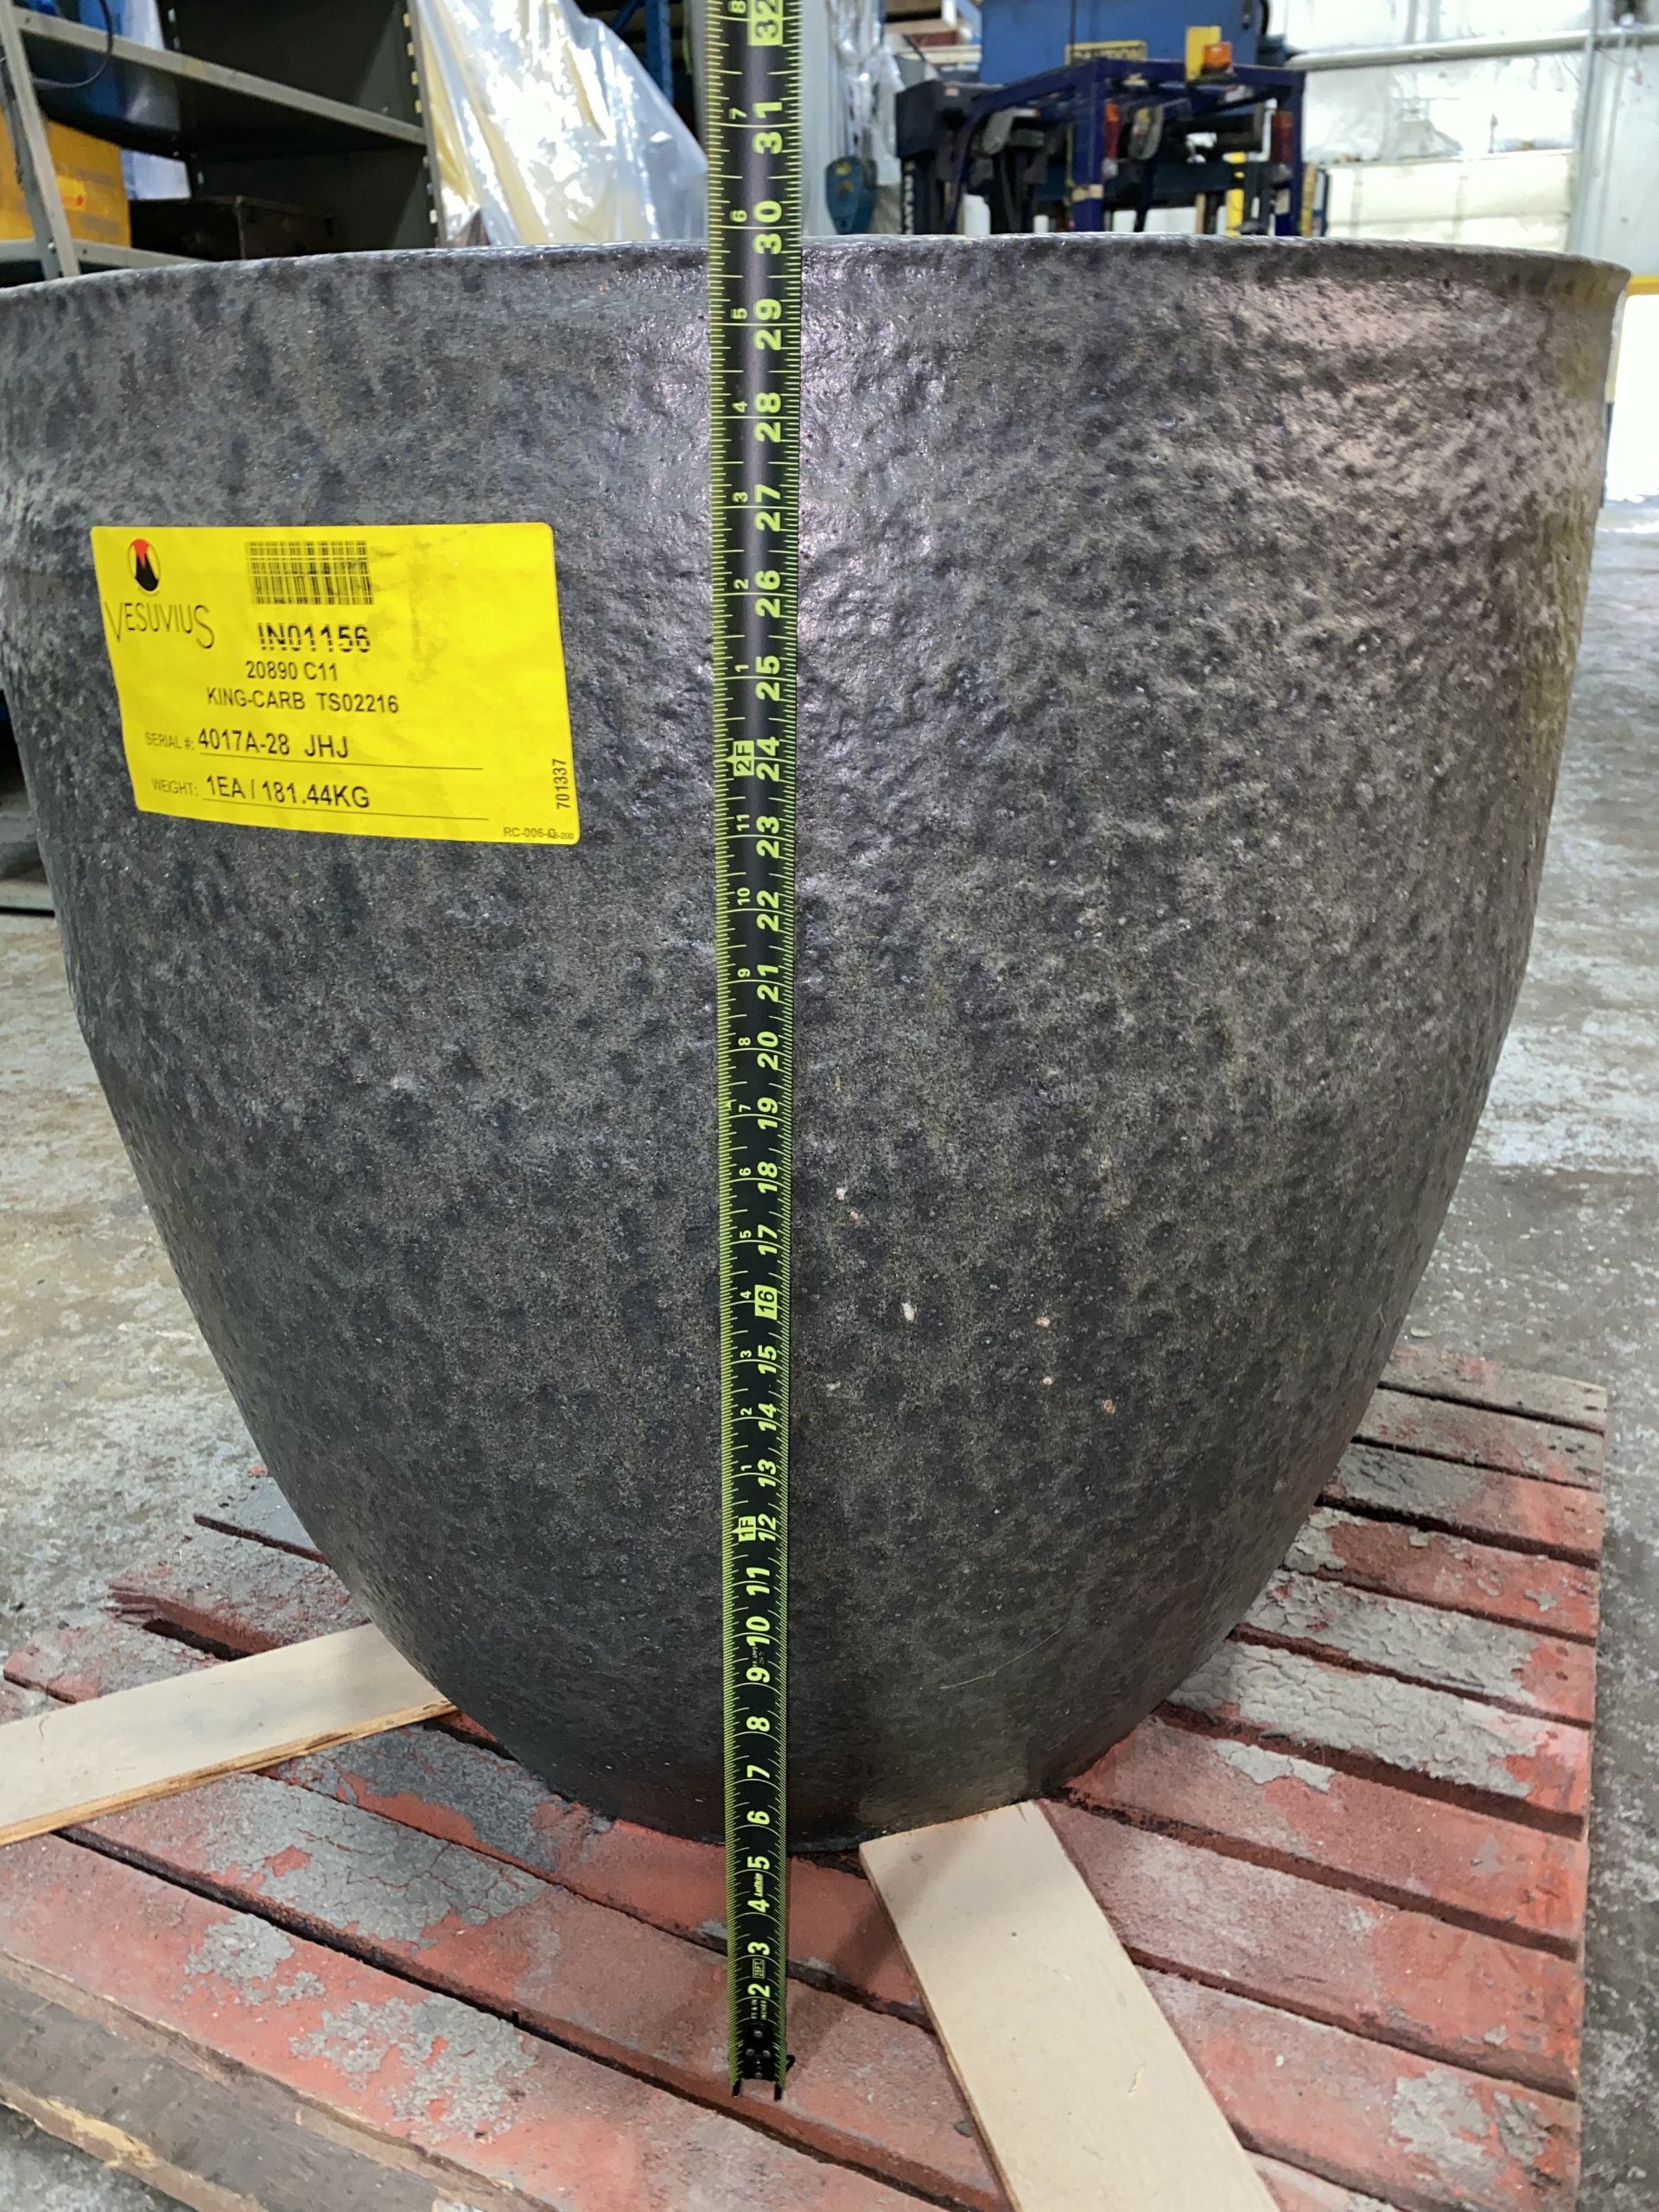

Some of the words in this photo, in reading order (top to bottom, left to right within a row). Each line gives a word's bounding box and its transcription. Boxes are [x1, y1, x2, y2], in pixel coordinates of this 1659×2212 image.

[728, 0, 747, 14] 8
[754, 0, 779, 38] 32
[728, 108, 747, 120] 7
[753, 102, 783, 154] 31
[729, 209, 747, 222] 6
[753, 200, 782, 254] 30
[730, 308, 747, 320] 5
[753, 298, 782, 350] 29
[732, 401, 747, 413] 4
[754, 392, 781, 442] 28
[732, 492, 748, 503] 3
[753, 484, 780, 531] 27
[734, 579, 748, 589] 2
[754, 569, 780, 618] 26
[104, 601, 215, 649] VESUVIUS
[258, 622, 371, 652] IN01156
[245, 660, 298, 680] 20890
[303, 662, 338, 682] C11
[734, 664, 749, 672] 1
[755, 655, 780, 702] 25
[207, 687, 306, 709] KING-CARB
[316, 692, 399, 714] TS02216
[144, 732, 182, 749] SERIAL
[199, 728, 290, 755] 4017A-28
[304, 734, 349, 759] JHJ
[735, 743, 753, 772] 2F
[756, 736, 779, 782] 24
[207, 775, 246, 799] 1EA
[263, 782, 371, 809] 181.44KG
[552, 759, 570, 810] 701337
[736, 814, 750, 831] 11
[756, 816, 779, 858] 23
[736, 887, 751, 906] 10
[756, 890, 779, 931] 22
[737, 968, 751, 977] 9
[757, 964, 779, 1002] 21
[738, 1037, 751, 1046] 8
[757, 1031, 779, 1071] 20
[757, 1096, 778, 1129] 19
[739, 1167, 752, 1176] 6
[757, 1161, 778, 1193] 18
[758, 1224, 778, 1255] 17
[740, 1290, 752, 1300] 4
[758, 1290, 775, 1313] 16
[740, 1350, 752, 1358] 3
[758, 1344, 777, 1374] 15
[758, 1403, 777, 1431] 14
[758, 1459, 776, 1487] 13
[741, 1518, 754, 1538] 1F
[758, 1513, 776, 1541] 12
[746, 1567, 770, 1596] 11
[746, 1616, 770, 1646] 10
[746, 1667, 770, 1683] 9
[746, 1716, 770, 1732] 8
[747, 1764, 770, 1779] 7
[747, 1810, 770, 1825] 6
[747, 1856, 770, 1870] 5
[747, 1899, 770, 1913] 4
[747, 1942, 770, 1955] 3
[747, 1984, 770, 1998] 2
